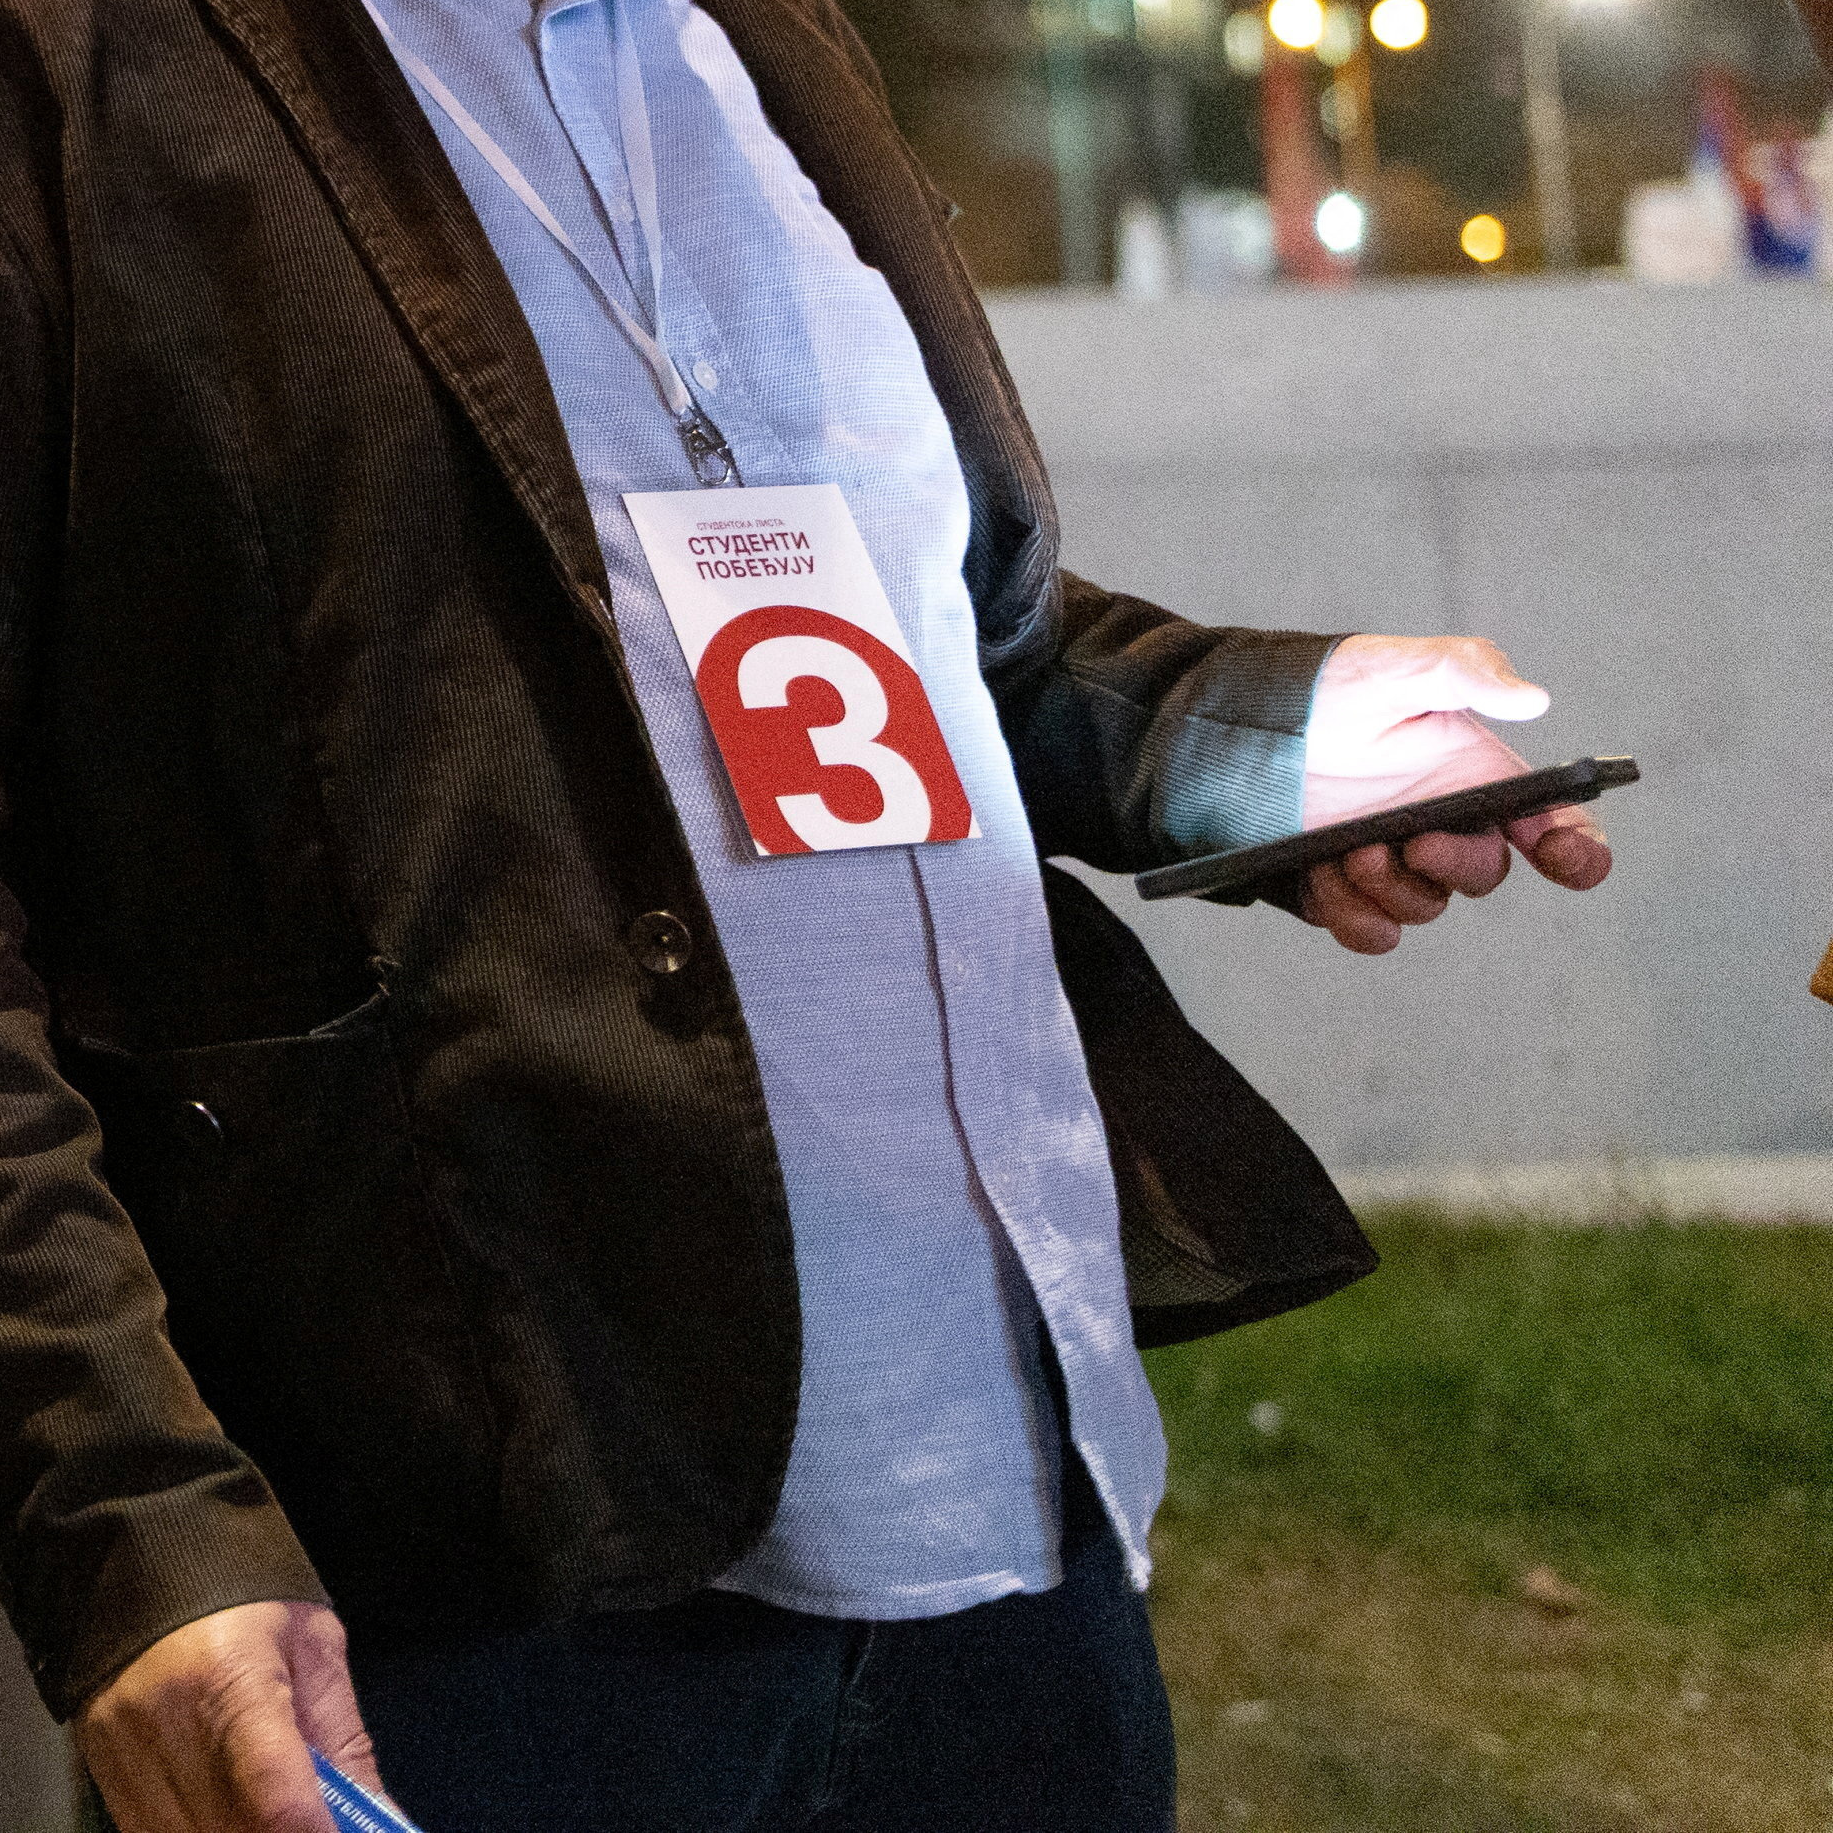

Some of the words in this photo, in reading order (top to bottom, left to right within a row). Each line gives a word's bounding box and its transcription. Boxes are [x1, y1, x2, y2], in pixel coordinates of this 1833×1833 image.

[688, 532, 810, 556] СТУДЕНТИ
[696, 556, 814, 580] ПОБЕЂУЈУ
[737, 634, 932, 852] 3
